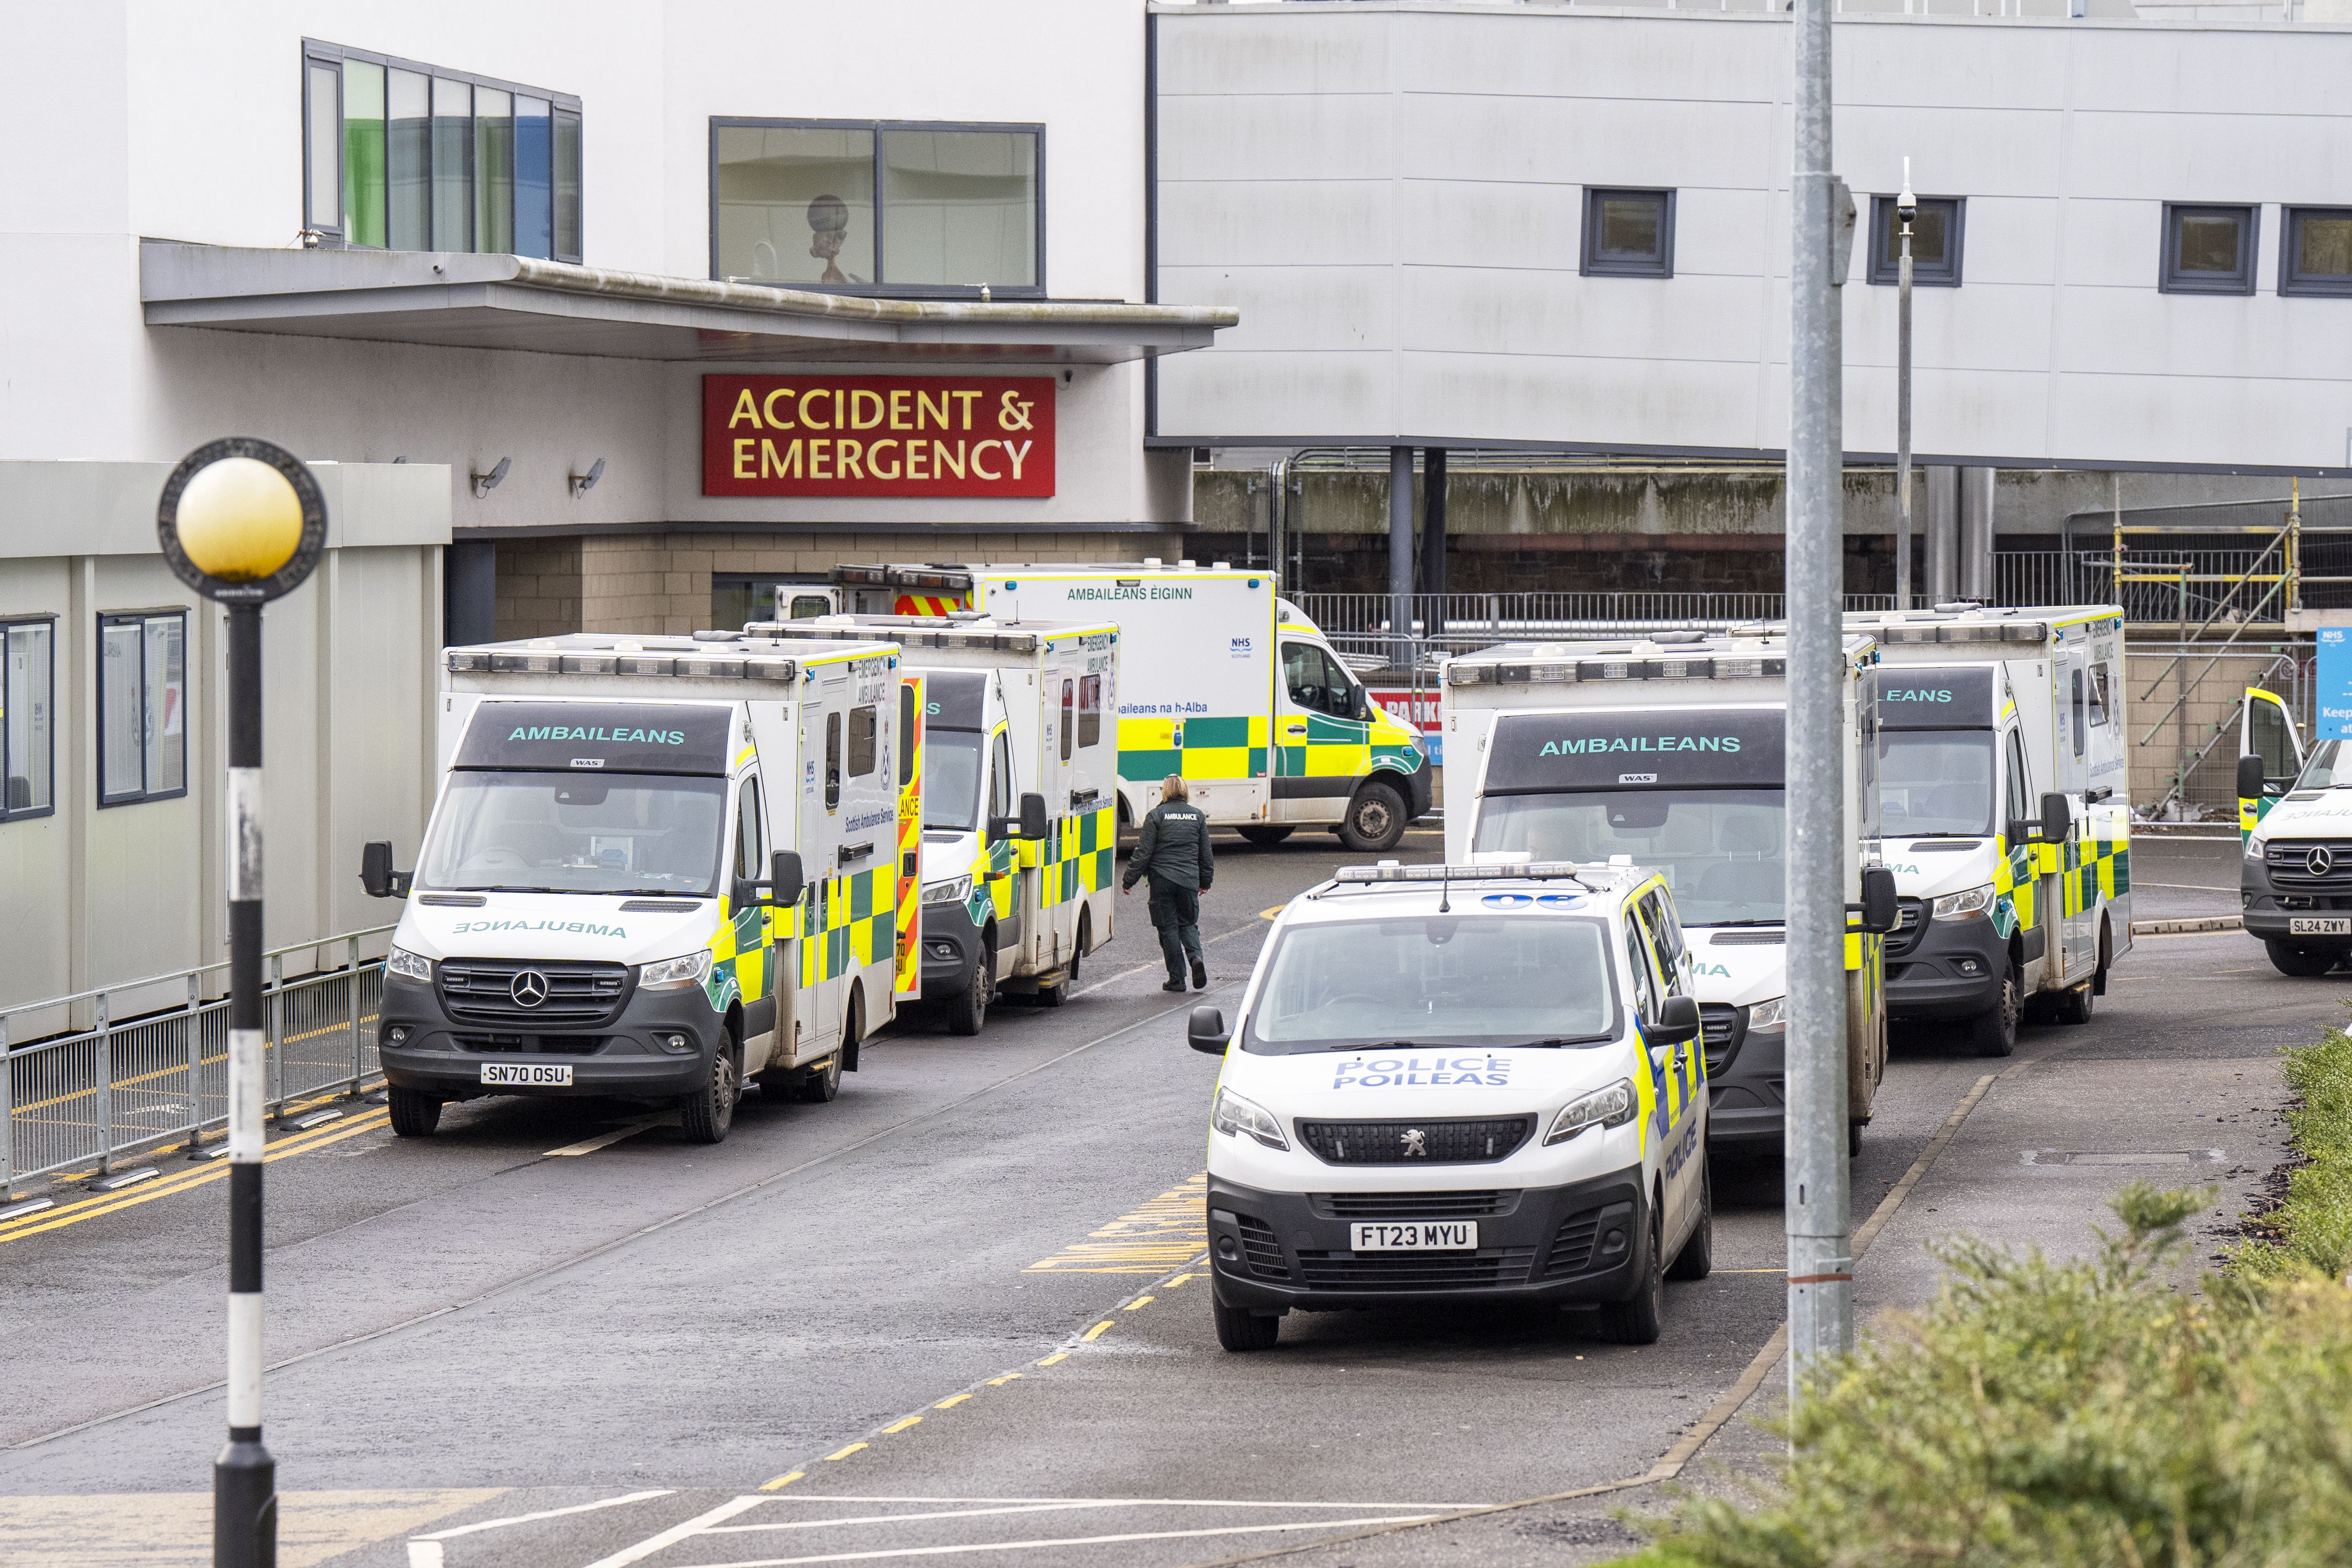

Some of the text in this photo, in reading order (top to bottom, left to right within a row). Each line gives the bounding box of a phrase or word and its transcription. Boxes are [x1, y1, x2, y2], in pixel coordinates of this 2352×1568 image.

[728, 388, 1034, 431] ACCIDENT &
[733, 439, 1033, 480] EMERGENCY
[1068, 585, 1192, 600] AMBAILEANS ÈIGINN
[1232, 638, 1250, 647] NHS
[859, 657, 886, 679] EMERGENCY
[858, 683, 885, 705] AMBULANCE
[1160, 705, 1172, 713] na
[1176, 702, 1208, 712] h-Alba
[508, 727, 685, 745] AMBAILEANS
[1539, 737, 1740, 757] AMBAILEANS
[846, 807, 893, 833] Scottish Ambulance Service
[2294, 920, 2344, 932] SL24 ZWY
[489, 1067, 564, 1082] SN70 OSU
[1336, 1058, 1512, 1075] POLICE
[1333, 1072, 1508, 1089] POILEAS
[1665, 1117, 1697, 1187] POLICE
[1361, 1225, 1466, 1246] FT23 MYU
